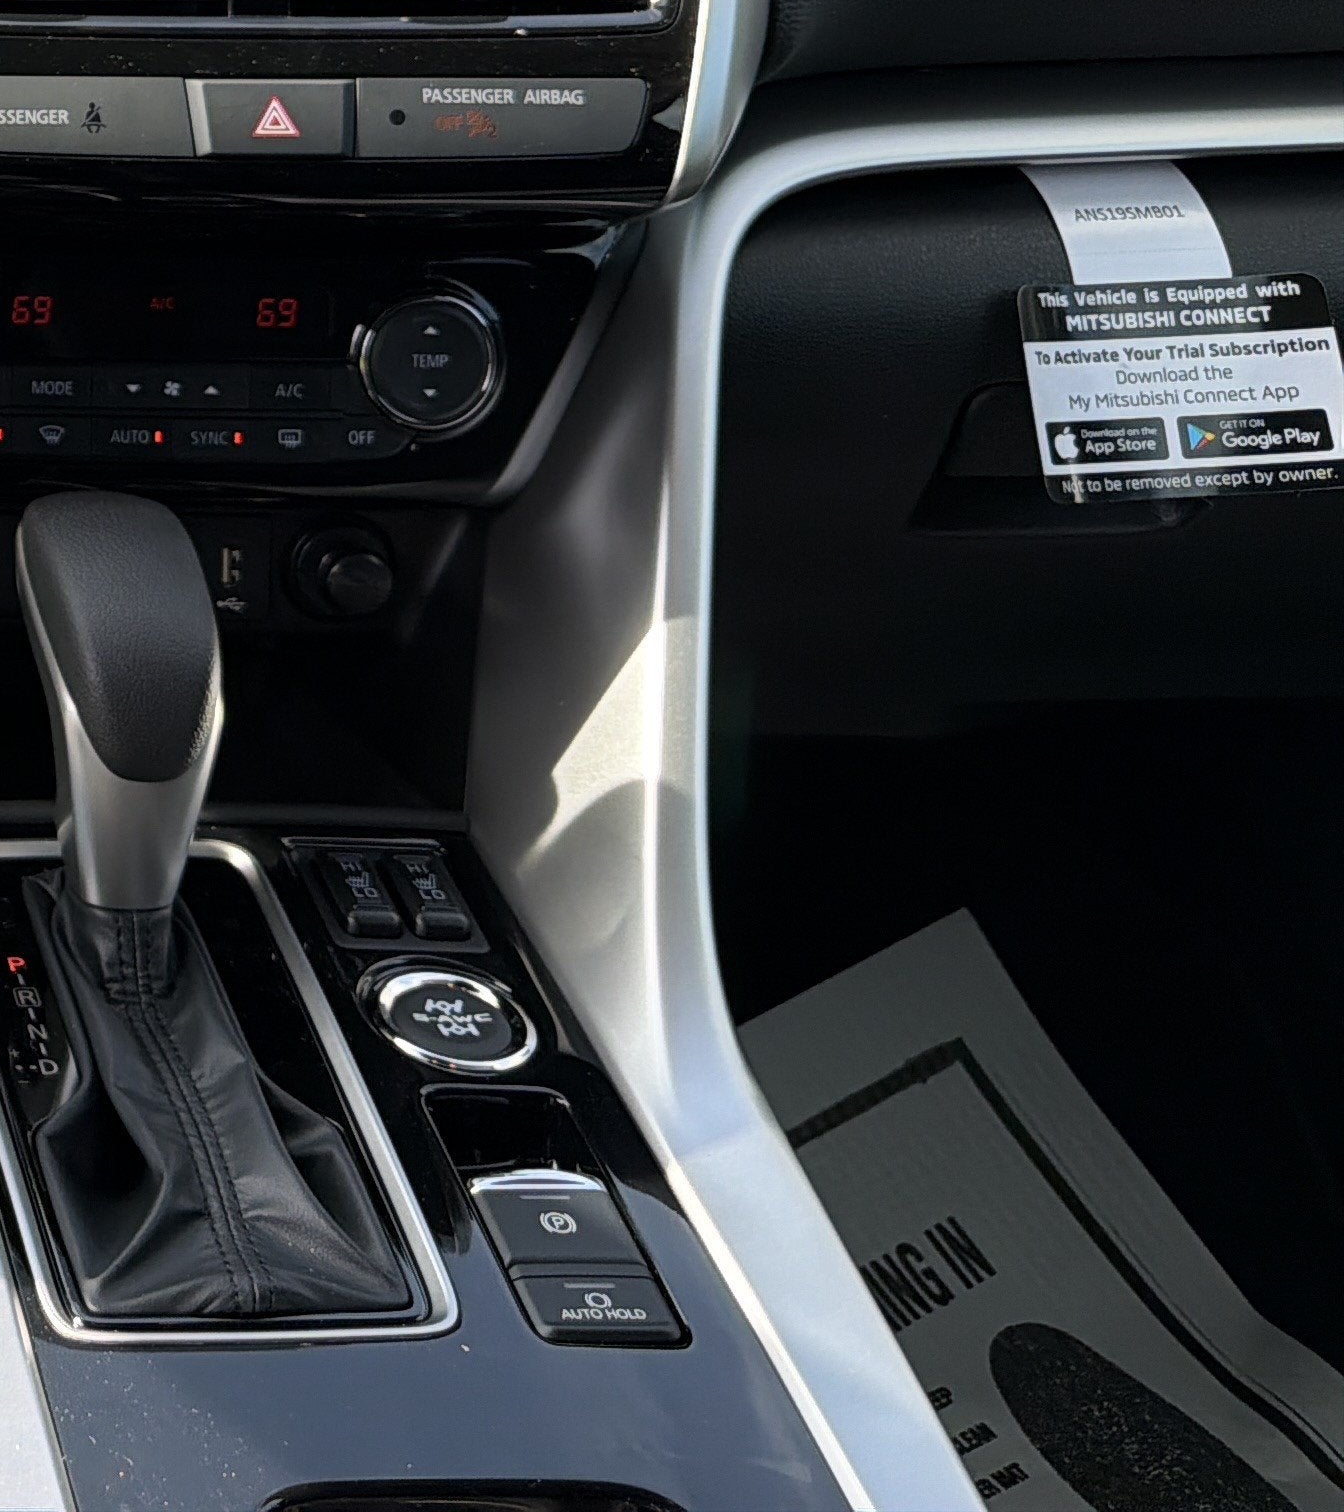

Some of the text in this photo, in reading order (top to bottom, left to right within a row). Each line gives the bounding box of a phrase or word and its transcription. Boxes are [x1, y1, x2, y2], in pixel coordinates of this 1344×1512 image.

[422, 89, 584, 105] PASSENGER AIRBAG
[1037, 280, 1301, 309] This Vehicle is Equipped with
[12, 296, 54, 326] 69
[257, 298, 299, 328] 69
[1066, 305, 1272, 332] MITSUBISHI CONNECT
[412, 353, 449, 368] TEMP
[1035, 338, 1330, 366] To Activate Your Trial Subscription
[1116, 365, 1234, 386] Download the
[31, 381, 73, 395] MODE
[275, 383, 303, 399] A/C
[1069, 385, 1300, 412] My Mitsubishi Connect App
[1080, 426, 1158, 439] Download on the
[1219, 420, 1237, 429] GET
[111, 430, 149, 443] AUTO
[191, 430, 228, 445] SYNC
[348, 430, 375, 445] OFF
[1221, 428, 1321, 450] Google Play
[1084, 437, 1157, 458] App Store
[1062, 465, 1338, 494] Not to be removed except by owner.
[7, 956, 26, 973] P
[18, 990, 37, 1005] R
[27, 1023, 48, 1040] N
[38, 1059, 59, 1076] D
[924, 1215, 997, 1289] IN
[562, 1308, 647, 1320] AUTO HOLD
